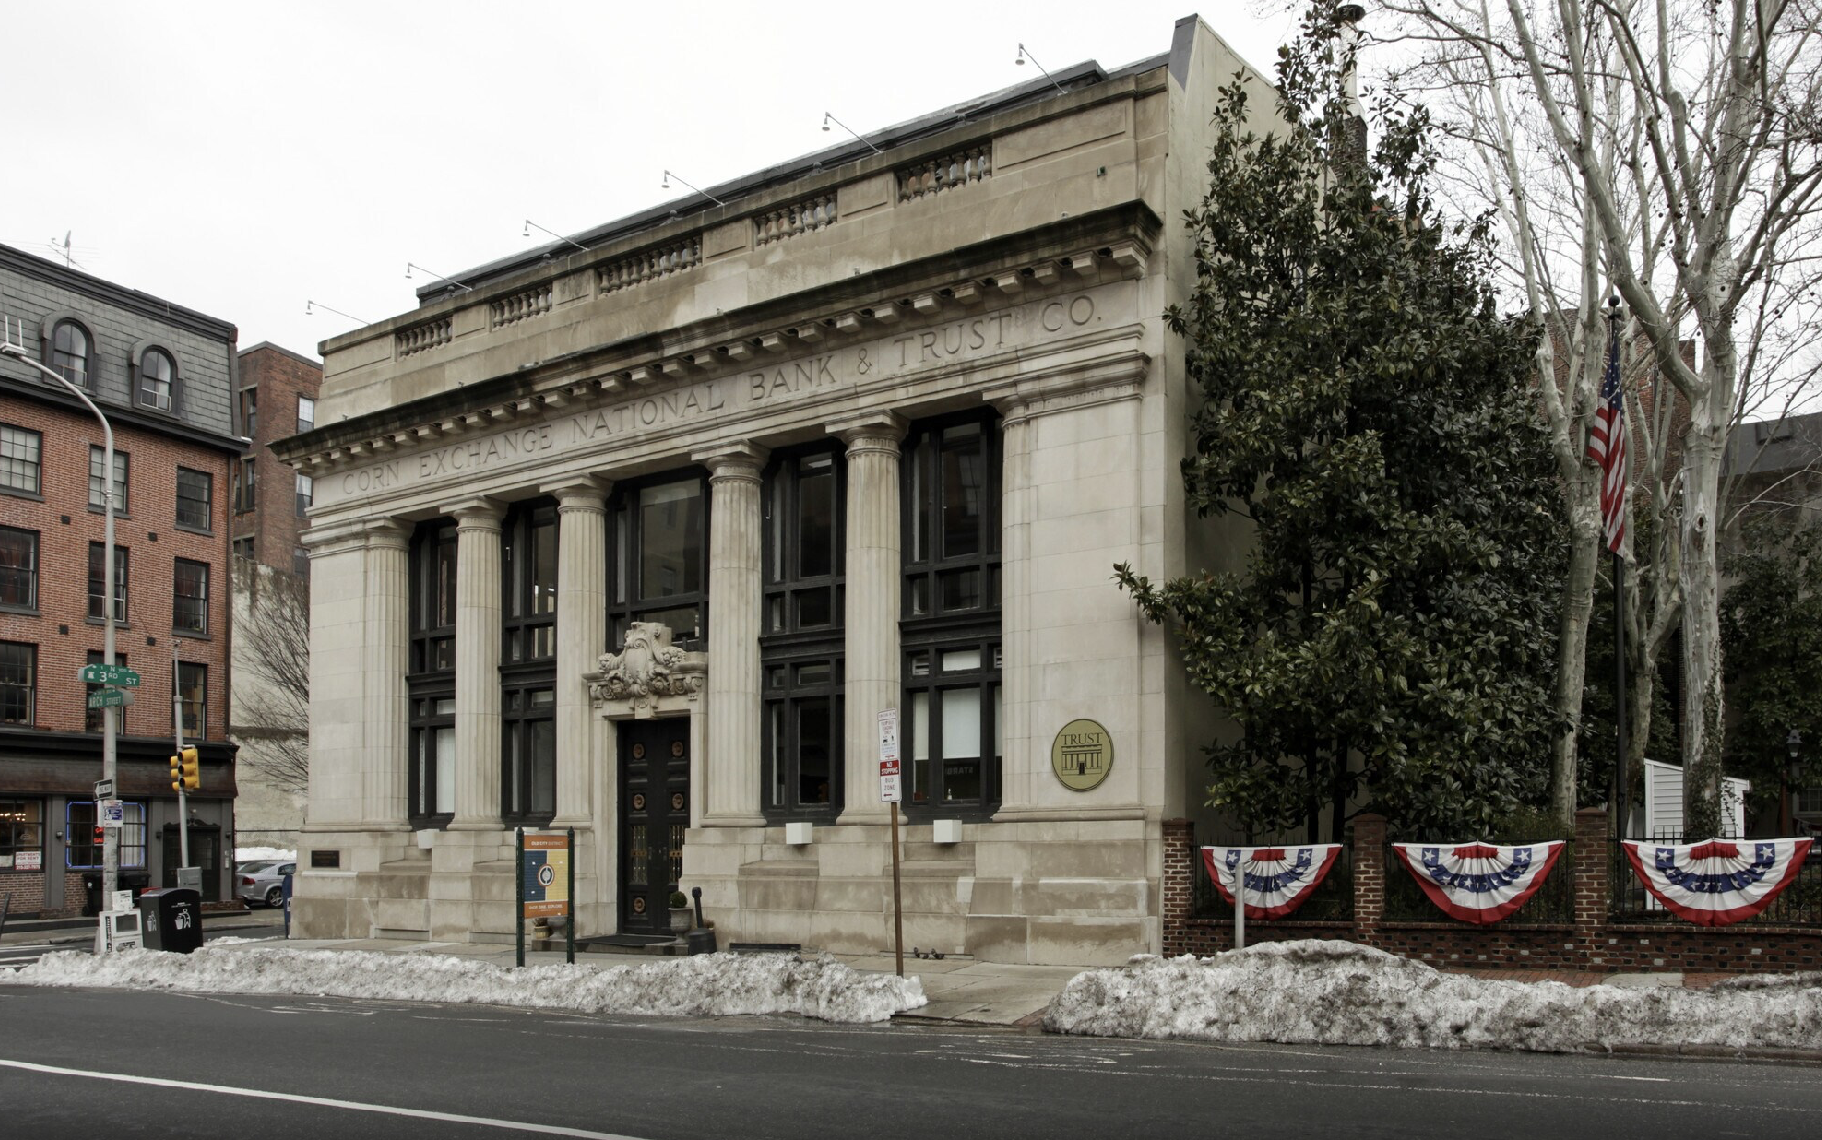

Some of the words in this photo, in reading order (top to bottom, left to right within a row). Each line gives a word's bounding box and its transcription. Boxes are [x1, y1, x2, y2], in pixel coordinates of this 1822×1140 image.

[342, 461, 400, 495] CORN
[419, 425, 553, 479] EXCHANGE
[572, 384, 725, 443] NATIONAL
[749, 355, 837, 401] BANK
[858, 347, 873, 375] &
[894, 313, 1013, 367] TRUST
[1041, 294, 1102, 332] CO.
[100, 671, 118, 682] 3RD
[126, 677, 137, 685] ST
[88, 696, 103, 708] ARCH
[106, 696, 121, 706] STREET
[1061, 732, 1103, 745] TRUST
[881, 767, 898, 775] STOPPING
